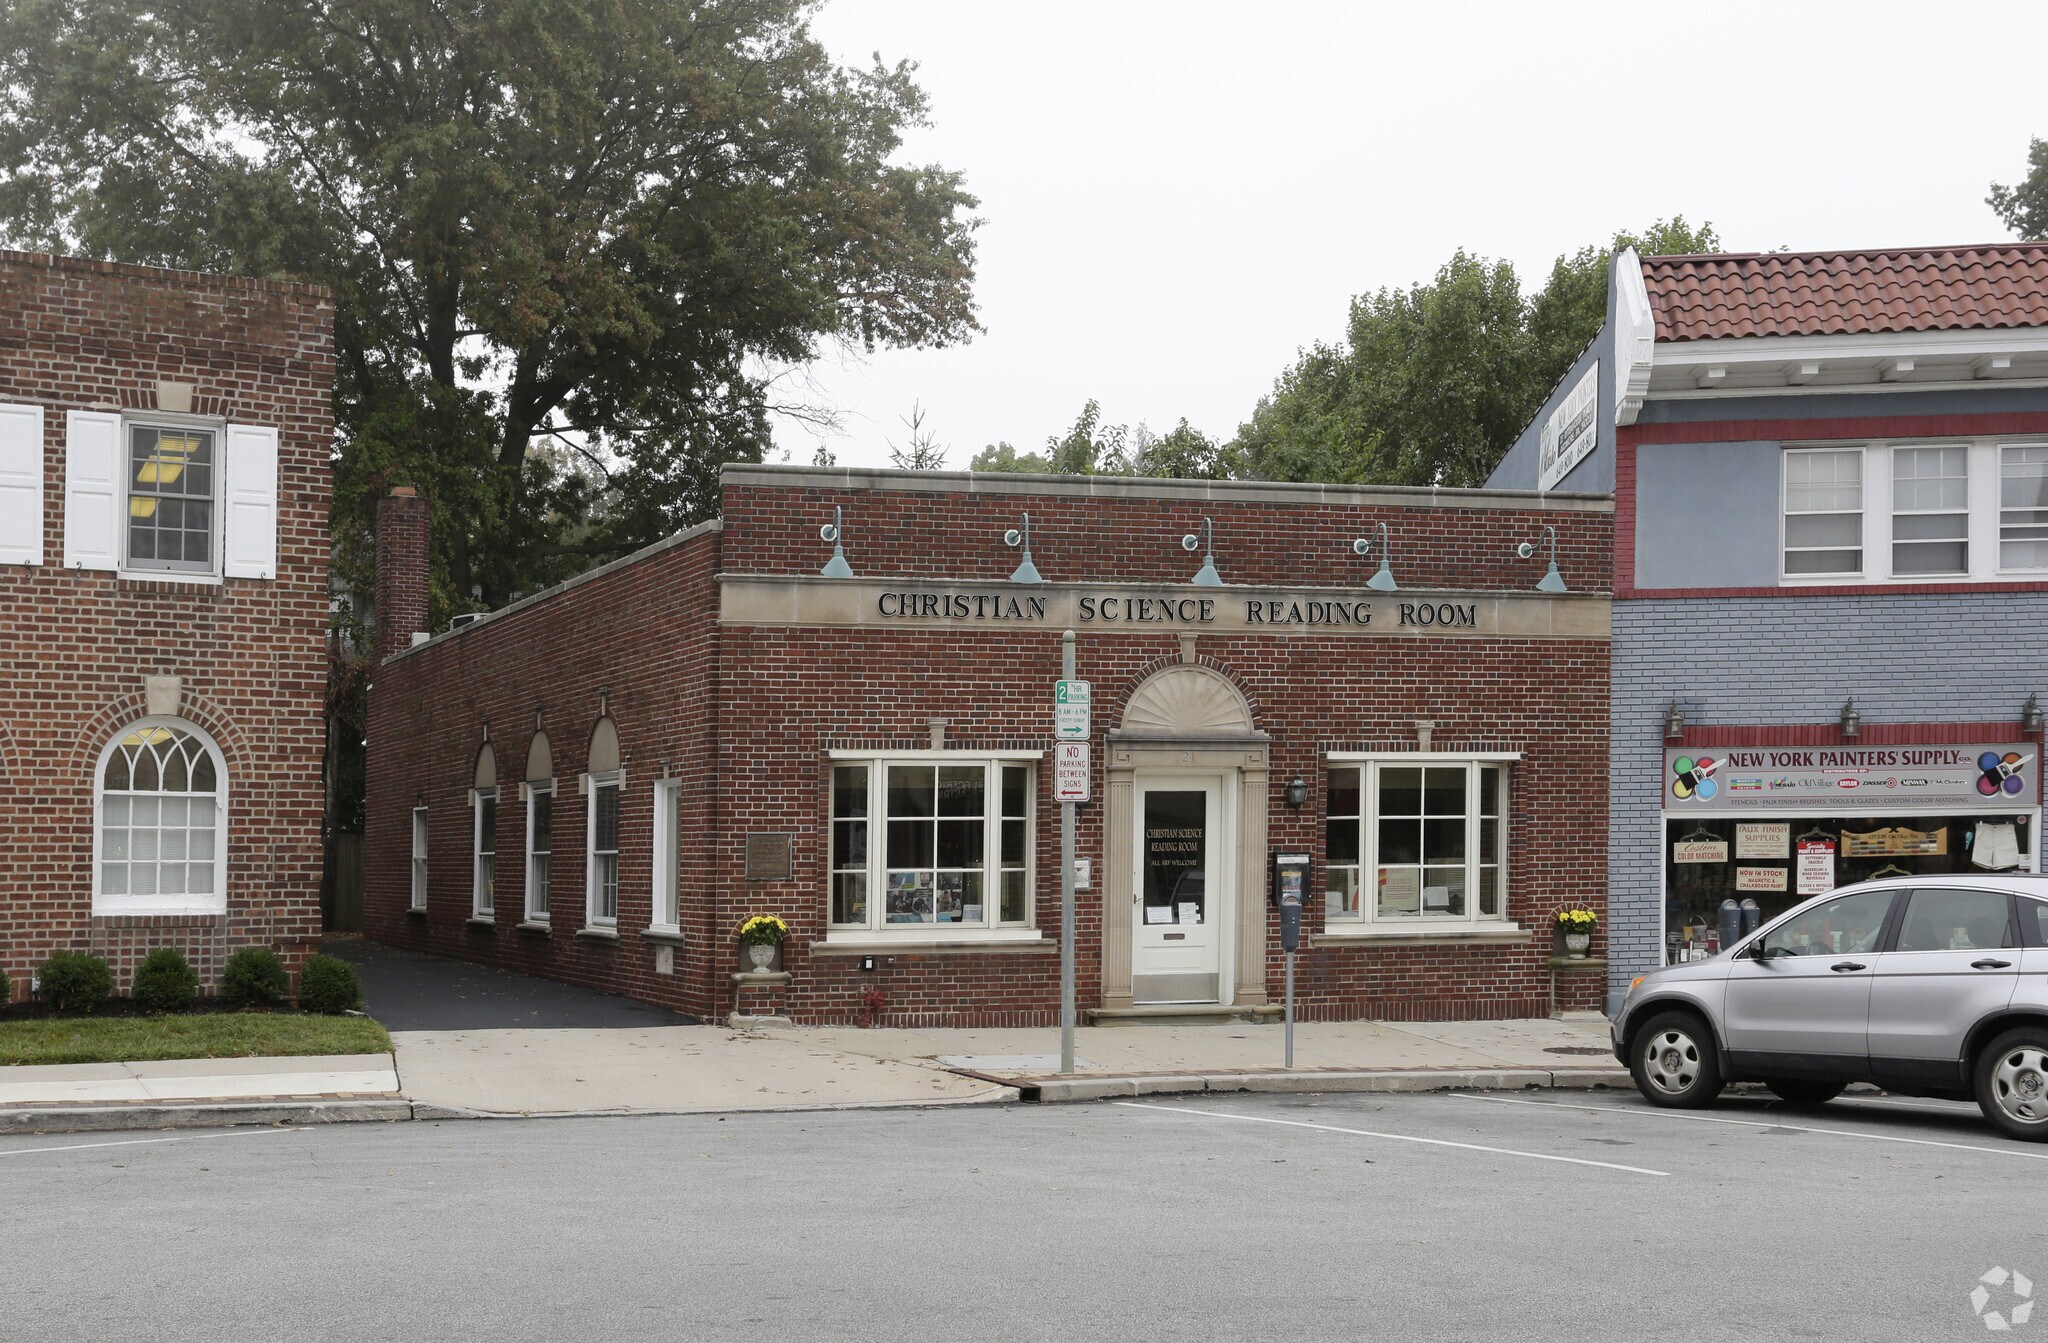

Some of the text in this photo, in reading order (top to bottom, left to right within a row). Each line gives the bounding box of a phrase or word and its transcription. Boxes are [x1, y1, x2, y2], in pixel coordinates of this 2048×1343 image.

[878, 592, 1477, 626] CHRISTIAN SCIENCE READING ROOM
[1059, 685, 1066, 700] 2
[1066, 747, 1079, 758] NO
[1182, 752, 1195, 763] 21
[1060, 760, 1086, 768] PARKING
[1728, 752, 1765, 767] NEW
[1769, 752, 1814, 767] YORK
[1819, 751, 1898, 766] PAINTERS'
[1902, 750, 1960, 765] SUPPLY
[1064, 780, 1082, 788] SIGNS
[1146, 828, 1202, 839] CHRISTIAN SCIENCE
[1151, 842, 1198, 851] READING ROOM
[1684, 843, 1717, 852] Custom
[1695, 852, 1724, 860] MATCHING
